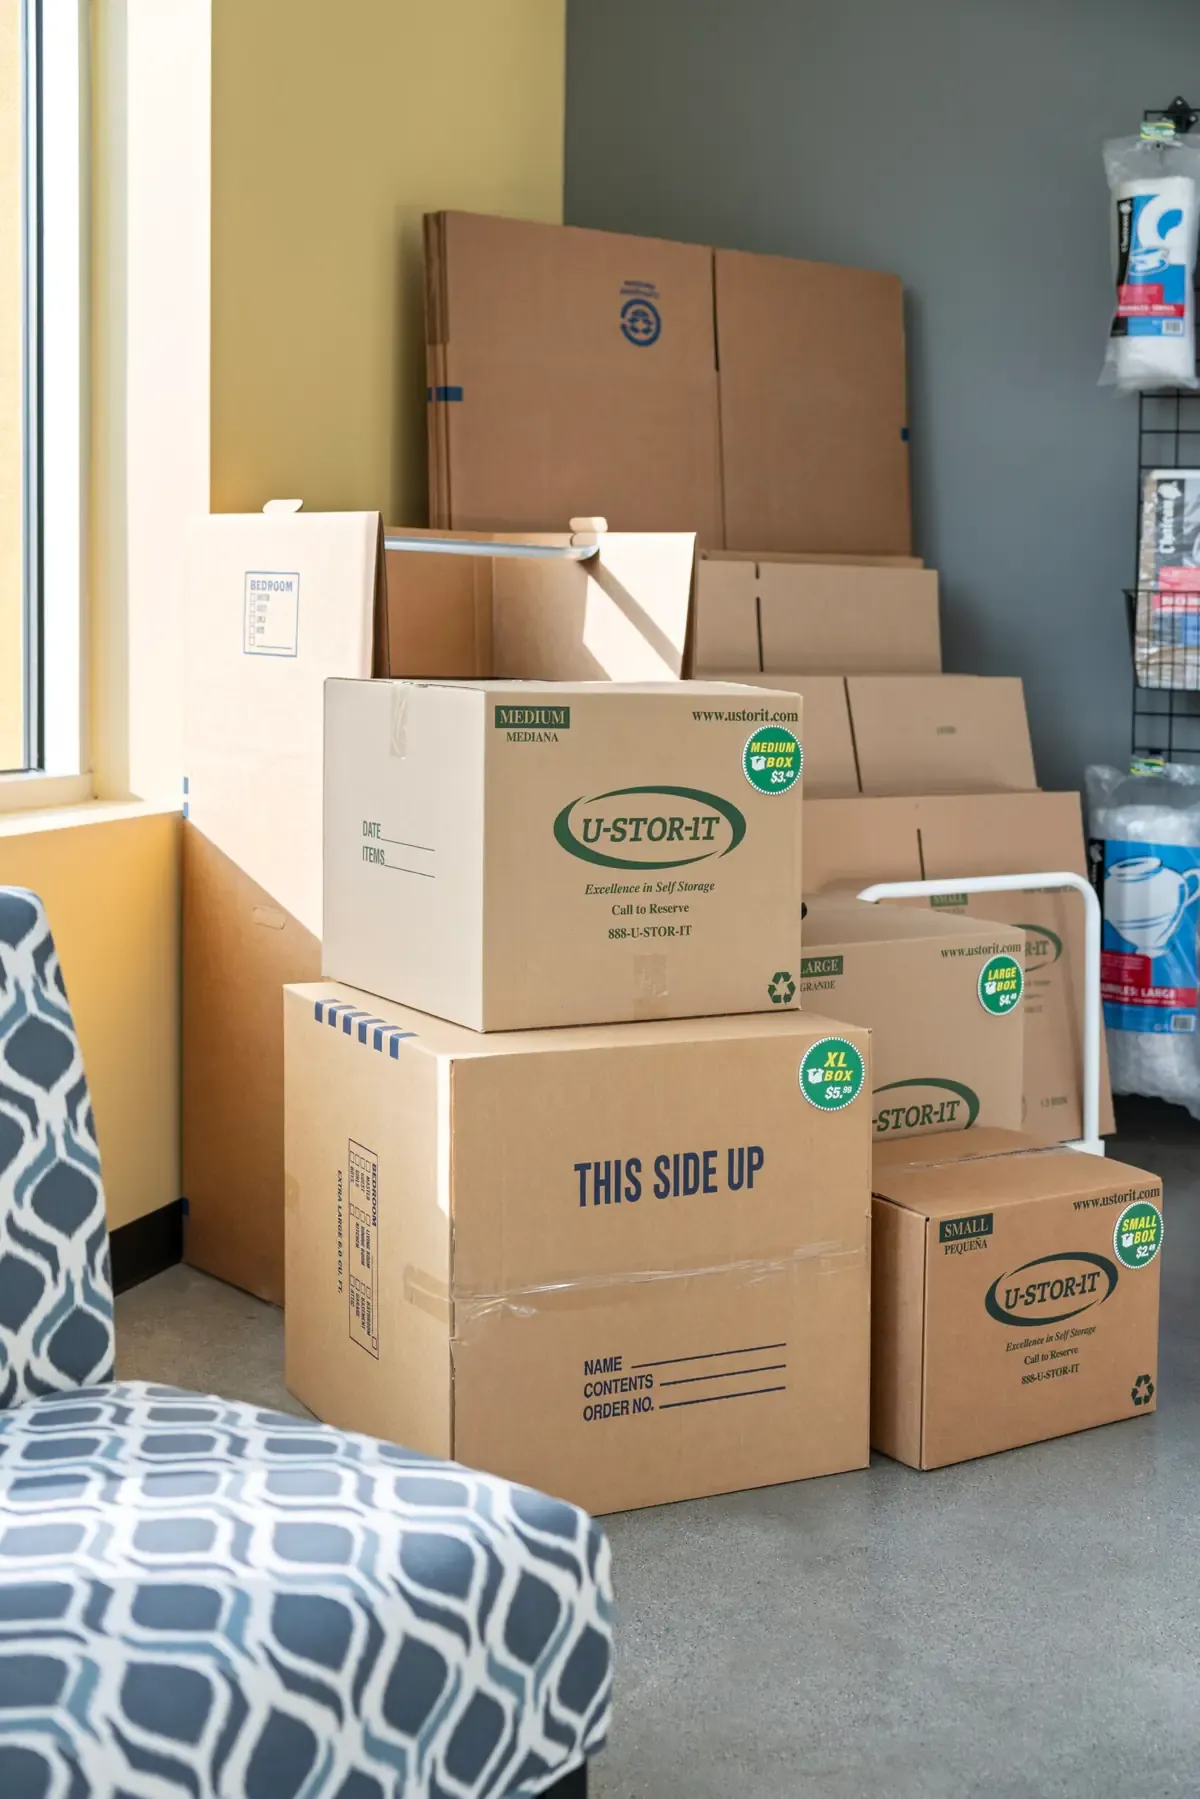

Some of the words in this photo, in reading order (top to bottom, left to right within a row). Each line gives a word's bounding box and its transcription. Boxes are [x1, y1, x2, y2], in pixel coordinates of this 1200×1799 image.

[249, 579, 294, 593] BEDROOM
[499, 708, 566, 726] MEDIUM
[691, 707, 799, 723] www.ustorit.com
[505, 731, 559, 743] MEDIANA
[750, 741, 796, 753] MEDIUM
[766, 756, 793, 768] BOX
[770, 769, 795, 784] $3.49
[362, 820, 382, 840] DATE
[582, 816, 721, 843] U-STOR-IT
[362, 845, 386, 866] ITEMS
[584, 882, 641, 895] Excellence
[642, 881, 653, 893] in
[655, 879, 678, 895] Self
[677, 879, 716, 894] Storage
[611, 903, 633, 916] Call
[635, 904, 647, 915] to
[648, 902, 690, 915] Reserve
[607, 924, 693, 940] 888-U-STOR-IT
[940, 942, 1022, 958] www.ustorit.com
[801, 958, 839, 974] ARGE
[987, 966, 1017, 981] LARGE
[996, 979, 1017, 992] BOX
[824, 1051, 848, 1068] XL
[823, 1069, 854, 1082] BOX
[824, 1085, 853, 1100] $5.99
[871, 1100, 961, 1133] -STOR-IT
[573, 1157, 642, 1207] THIS
[653, 1149, 718, 1199] SIDE
[727, 1145, 765, 1191] UP
[1072, 1187, 1161, 1212] www.ustorit.com
[944, 1218, 989, 1239] SMALL
[1121, 1214, 1157, 1232] SMALL
[1133, 1229, 1157, 1245] BOX
[944, 1237, 988, 1256] PEQUEÑA
[1004, 1271, 1101, 1310] U-STOR-IT
[1005, 1337, 1045, 1353] Excellence
[1045, 1333, 1054, 1344] in
[1054, 1329, 1070, 1343] Self
[1069, 1325, 1097, 1339] Storage
[1023, 1353, 1040, 1366] Call
[1041, 1352, 1049, 1362] to
[1050, 1346, 1079, 1360] Reserve
[583, 1355, 623, 1376] NAME
[1020, 1363, 1080, 1386] 888-U-STOR-IT
[583, 1373, 654, 1399] CONTENTS
[582, 1400, 630, 1422] ORDER
[632, 1395, 655, 1414] NO.
